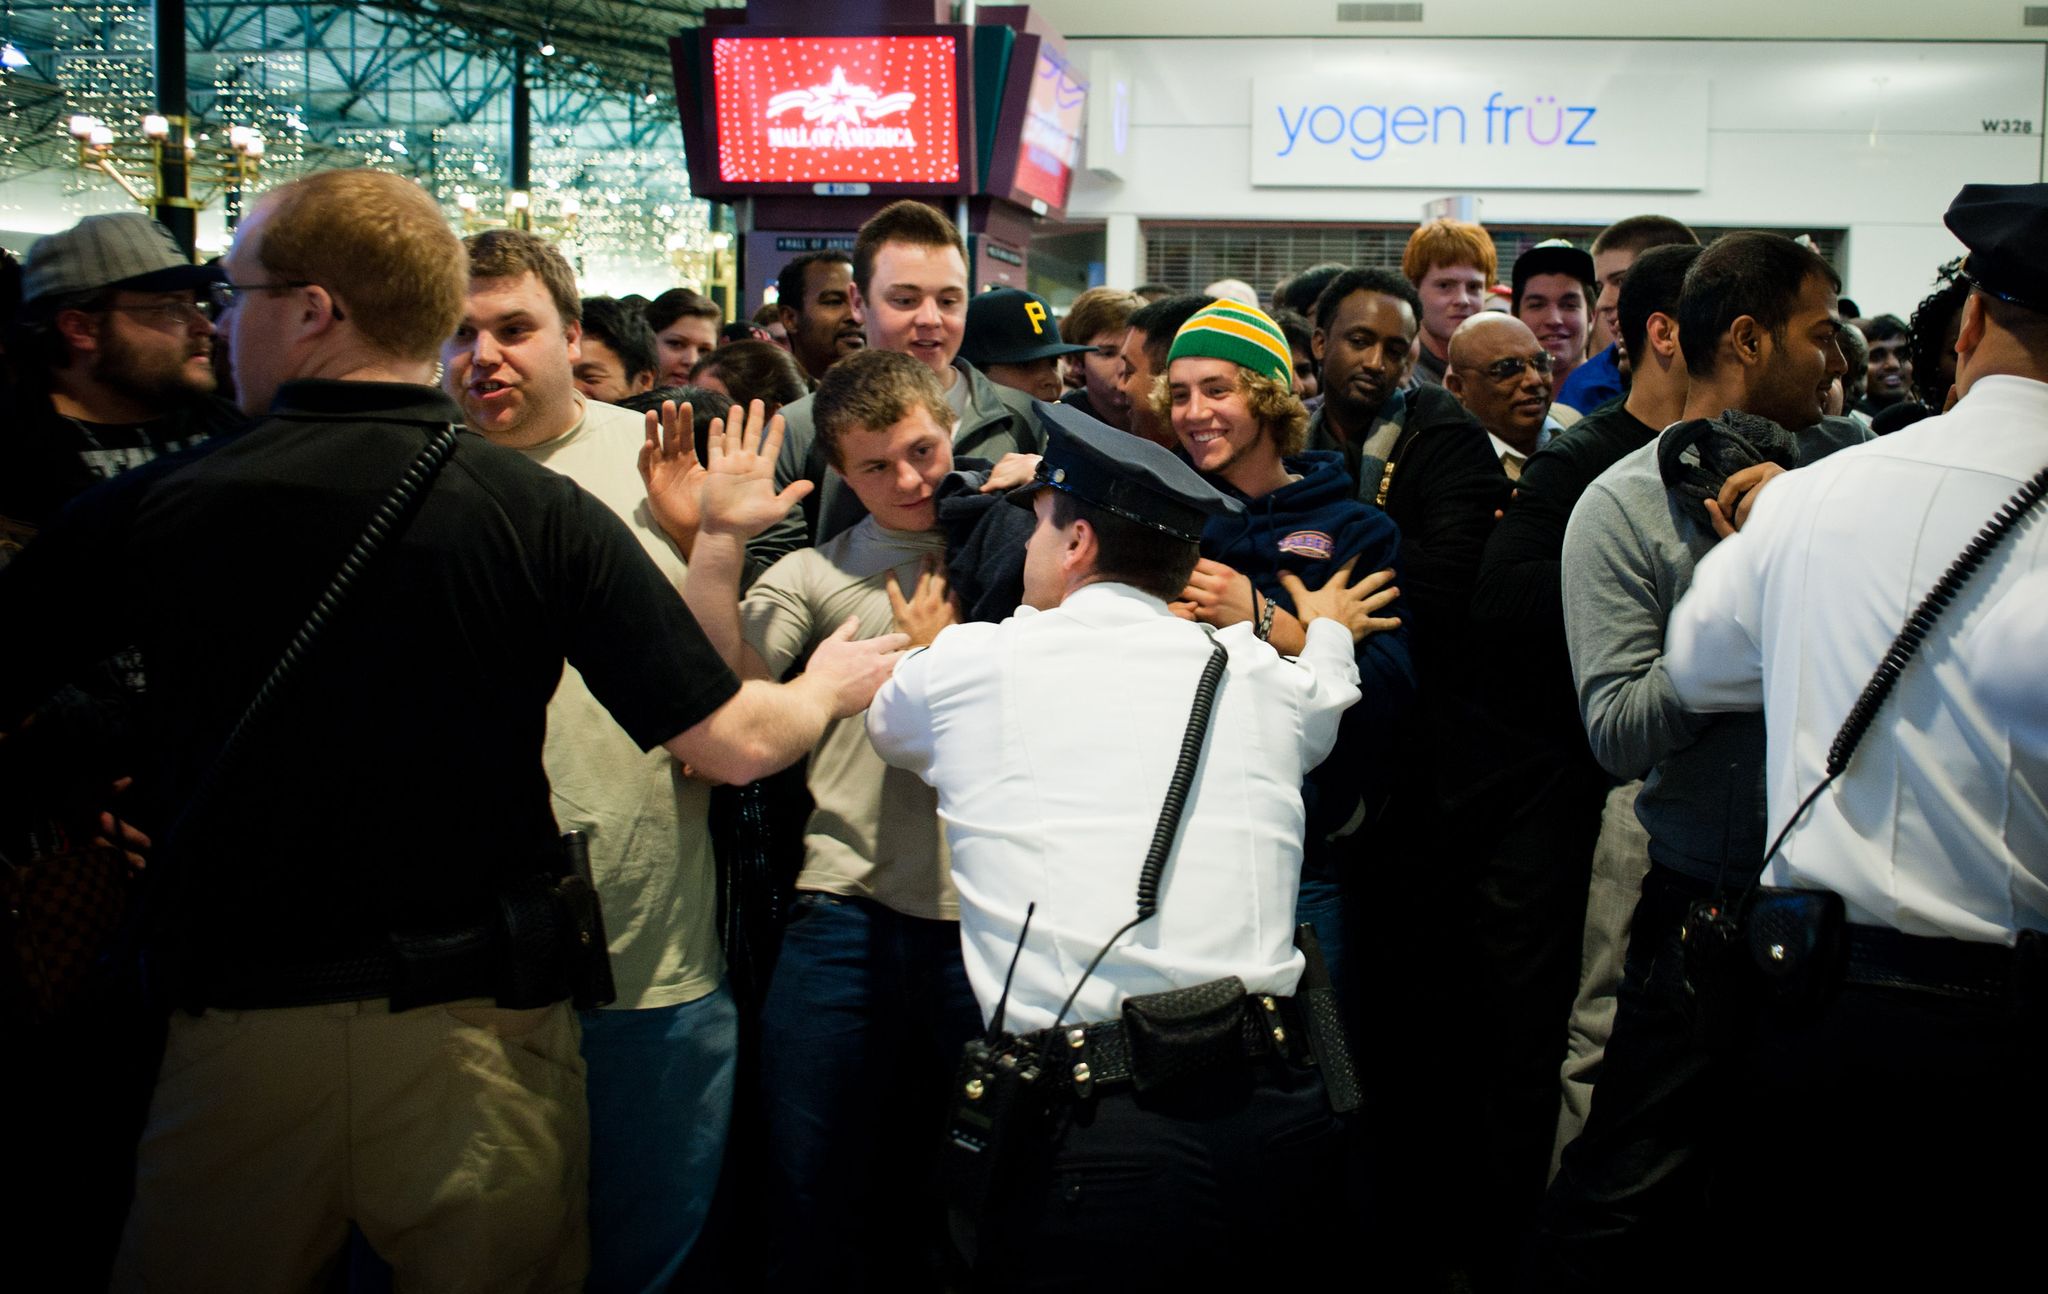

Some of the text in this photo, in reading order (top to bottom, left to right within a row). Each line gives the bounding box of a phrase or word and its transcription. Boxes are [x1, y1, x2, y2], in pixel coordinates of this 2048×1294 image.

[767, 119, 918, 149] MALL OF AMERICA
[1277, 91, 1597, 161] yogen früz
[1981, 118, 2033, 135] W328
[1023, 301, 1047, 335] P
